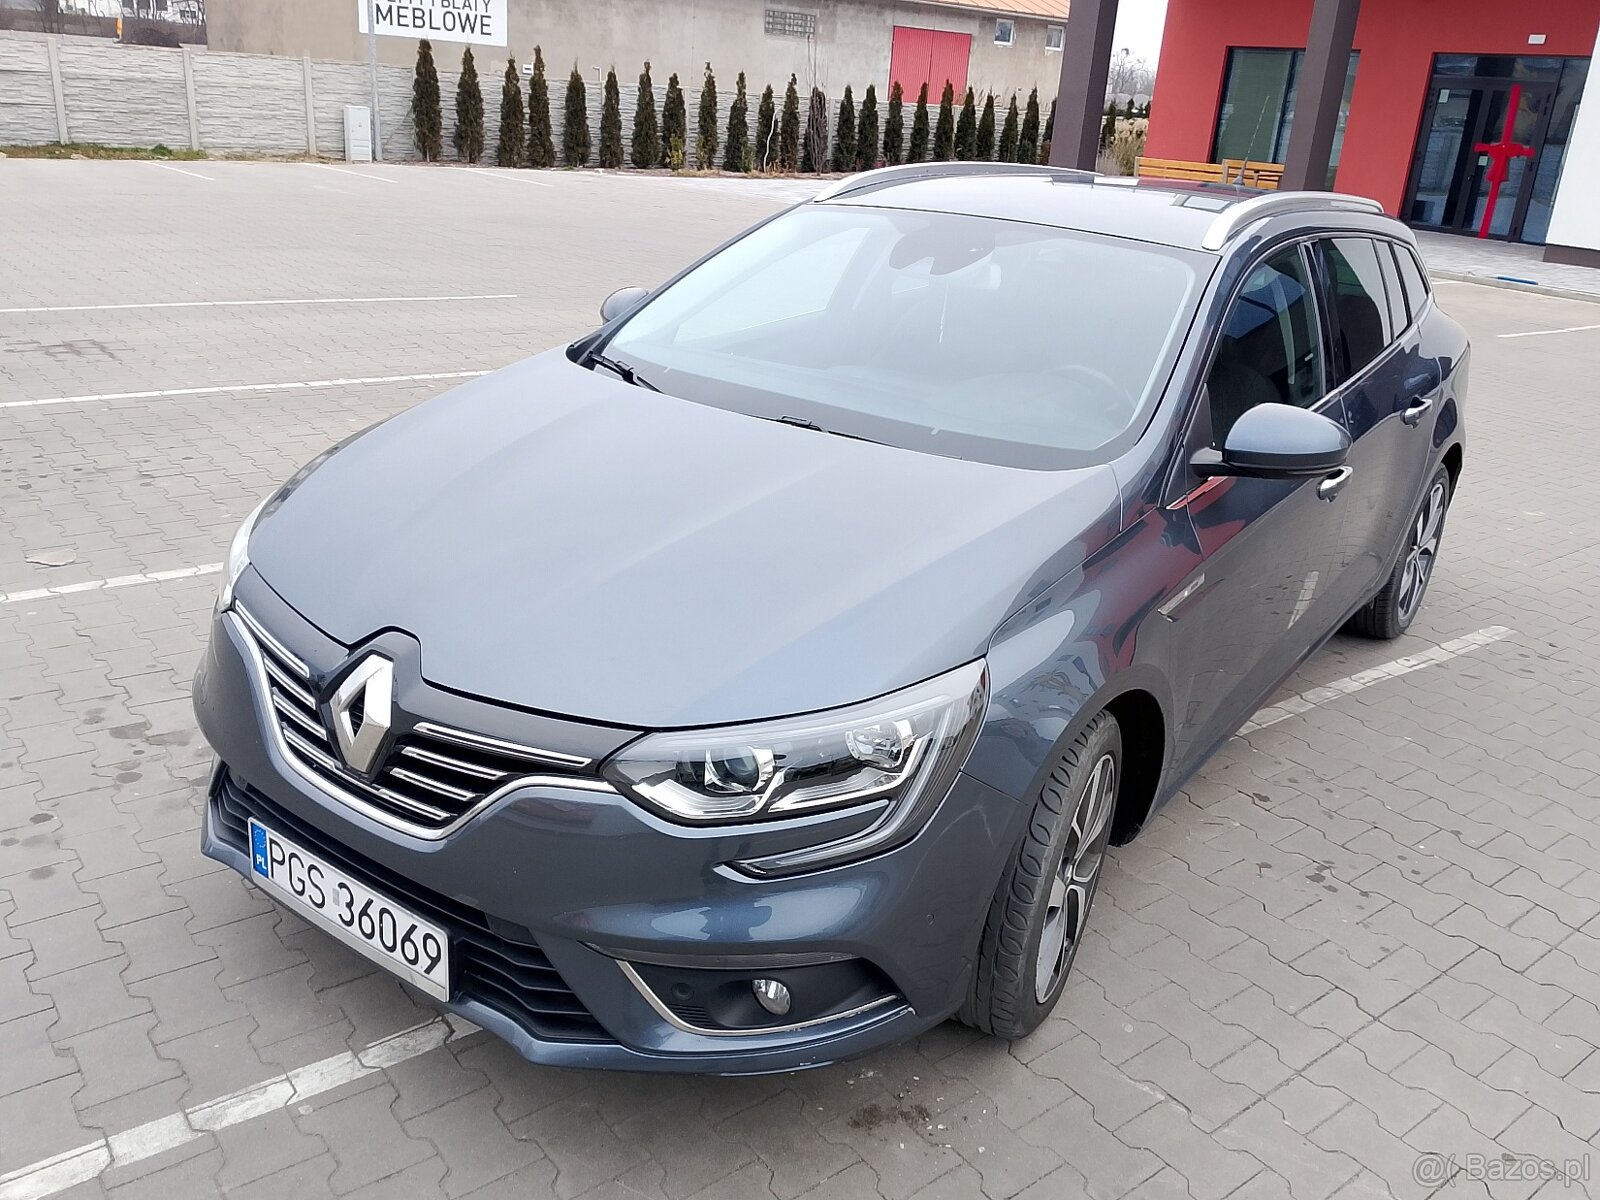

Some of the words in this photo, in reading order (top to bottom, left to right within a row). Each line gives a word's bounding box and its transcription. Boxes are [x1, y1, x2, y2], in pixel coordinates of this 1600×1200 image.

[375, 4, 492, 36] MEBLOWE
[256, 854, 268, 870] PL
[268, 837, 326, 909] PGS
[337, 882, 442, 975] 36069
